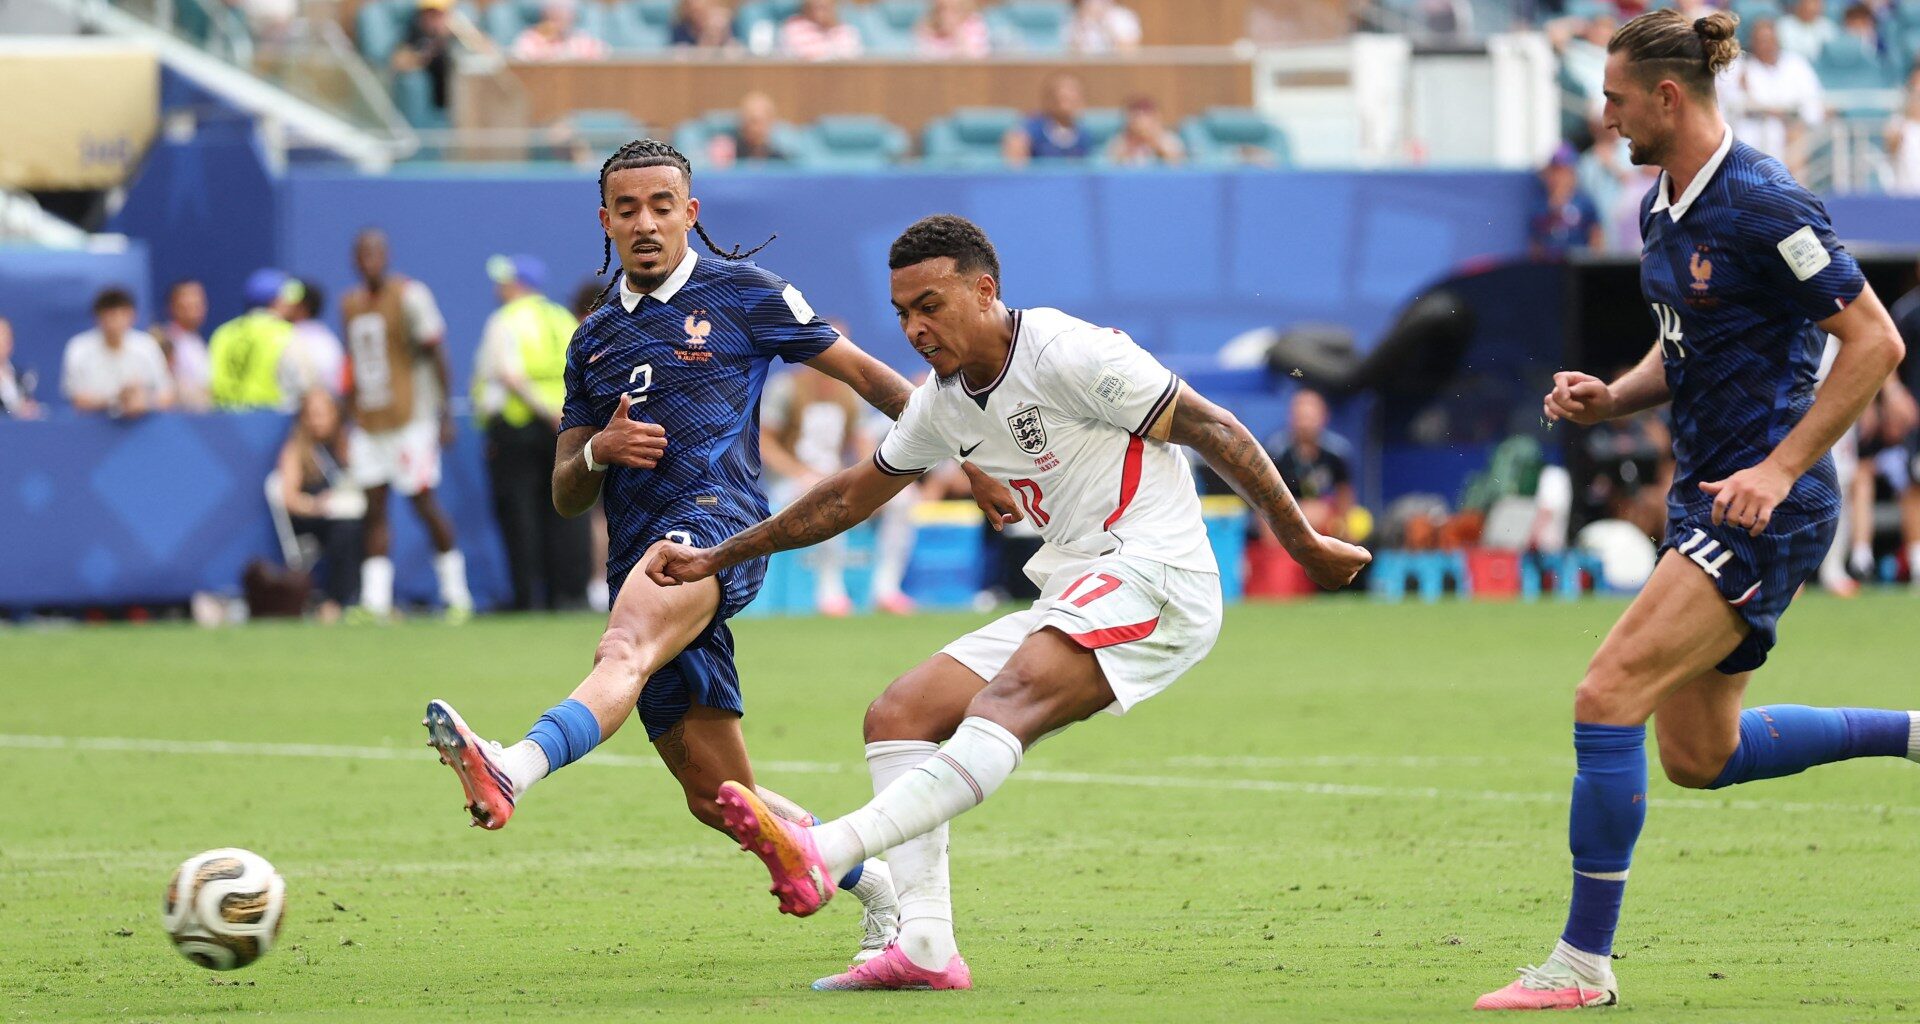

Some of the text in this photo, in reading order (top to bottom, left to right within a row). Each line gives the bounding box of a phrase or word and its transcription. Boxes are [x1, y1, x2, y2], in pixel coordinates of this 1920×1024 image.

[1651, 303, 1685, 358] 14
[629, 363, 653, 406] 2
[1101, 376, 1119, 399] UNITES
[1034, 451, 1056, 466] FRANCE
[1678, 528, 1734, 579] 14
[1057, 572, 1122, 608] 17
